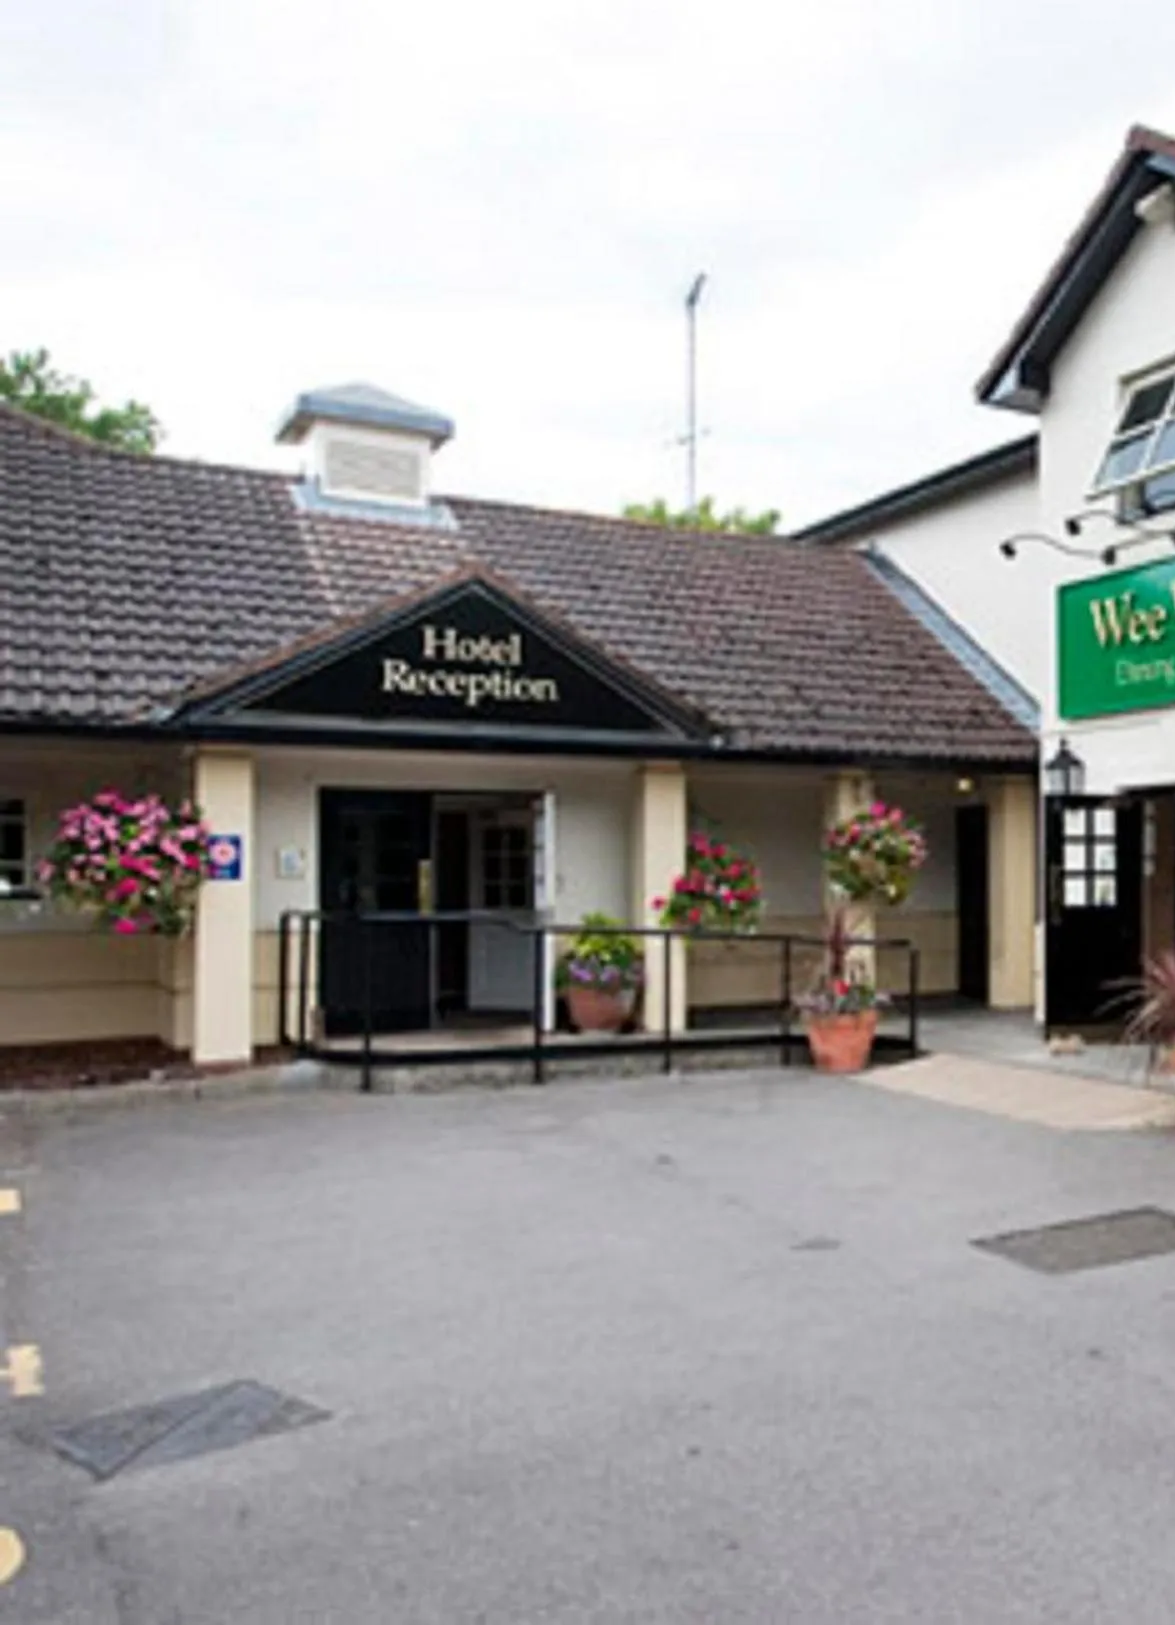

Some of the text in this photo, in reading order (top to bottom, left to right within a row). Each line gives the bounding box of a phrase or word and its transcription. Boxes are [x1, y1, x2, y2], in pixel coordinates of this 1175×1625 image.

[1089, 591, 1167, 647] Wee
[422, 625, 522, 666] Hotel
[382, 658, 560, 707] Reception
